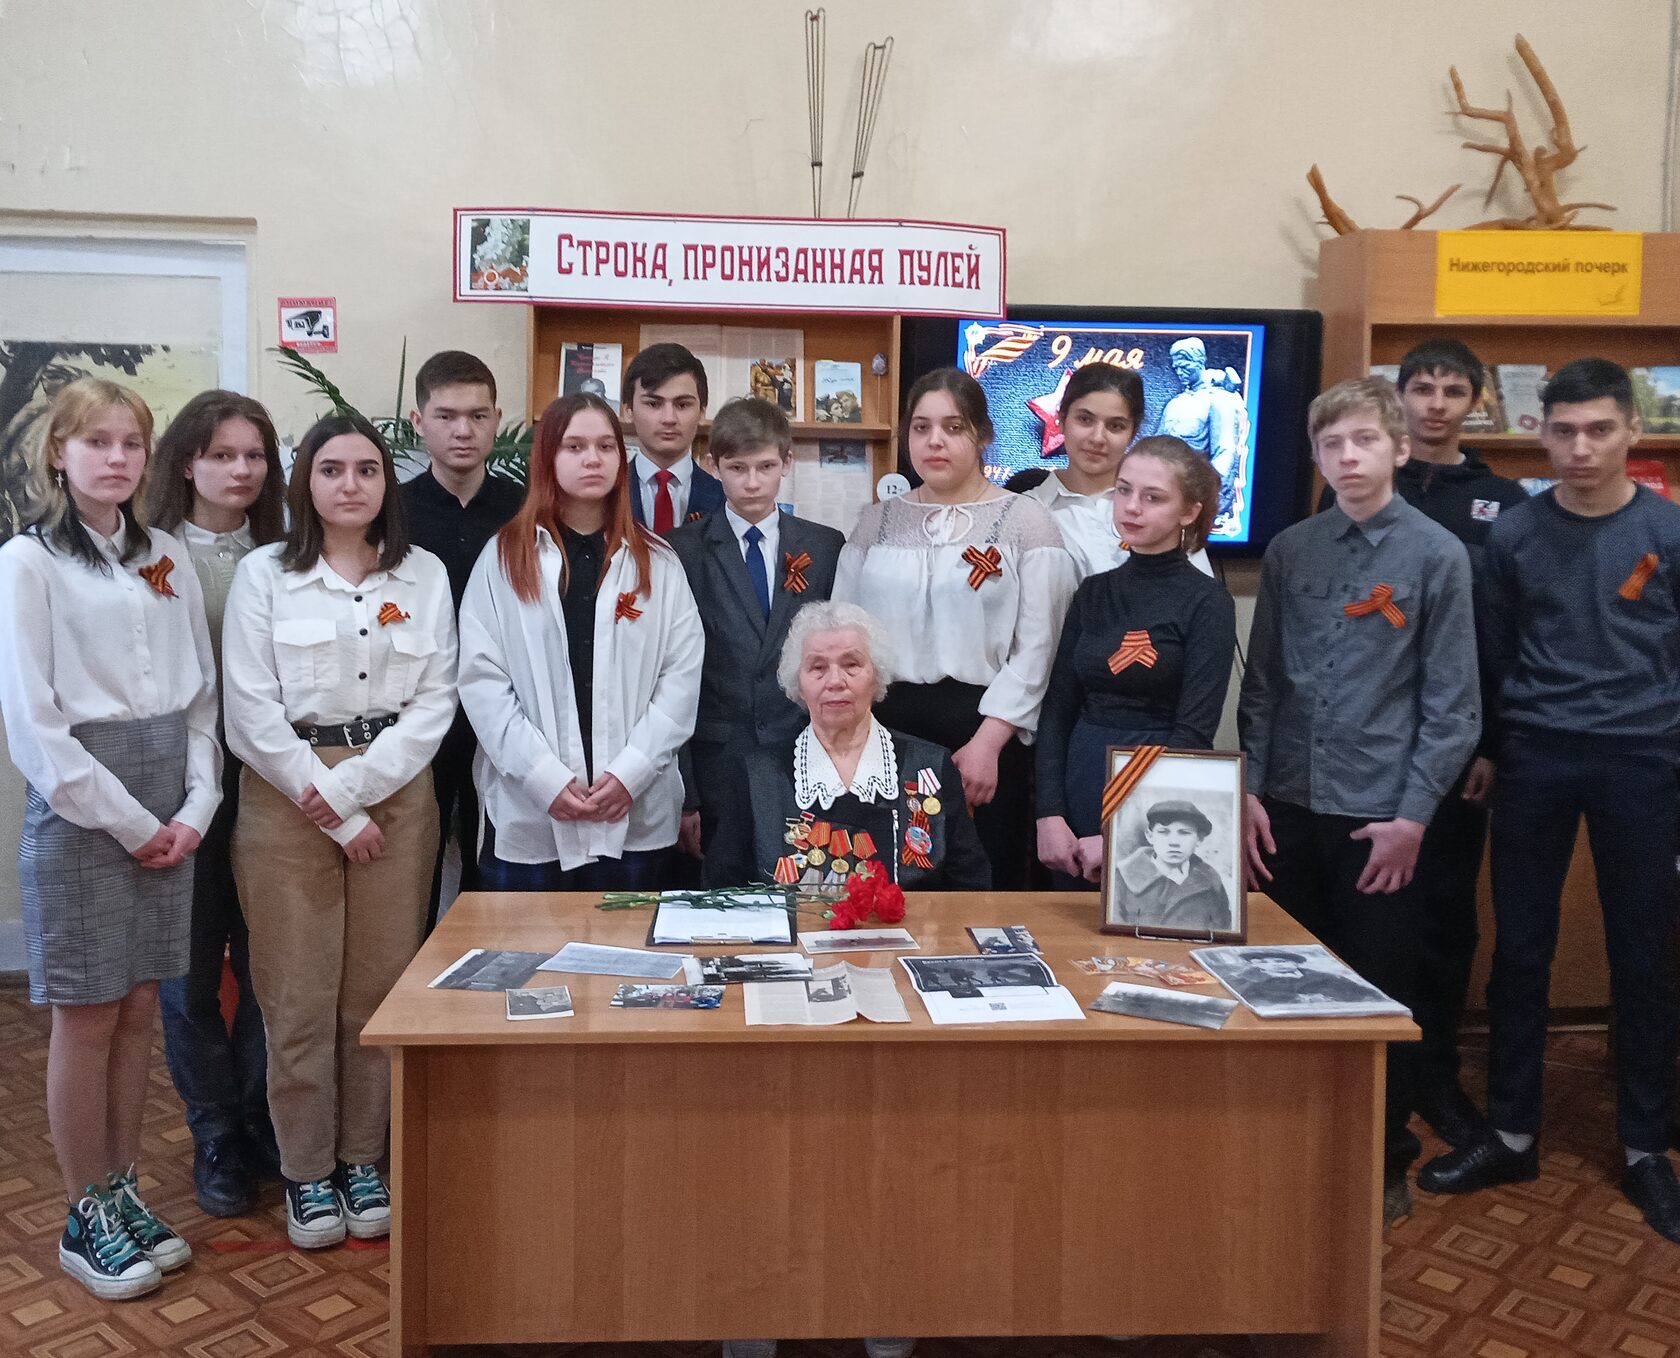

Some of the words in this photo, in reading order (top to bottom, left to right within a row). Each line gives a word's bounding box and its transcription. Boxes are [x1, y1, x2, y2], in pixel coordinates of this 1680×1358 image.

[557, 233, 673, 287] СТРОКА,
[682, 243, 884, 284] ПРОНИЗАННАЯ
[898, 243, 981, 290] ПУЛЕЙ
[1449, 257, 1570, 276] Нижегородский
[1575, 261, 1628, 276] почерк
[1047, 335, 1072, 369] 9
[1073, 347, 1144, 370] мая
[887, 484, 905, 495] 12+
